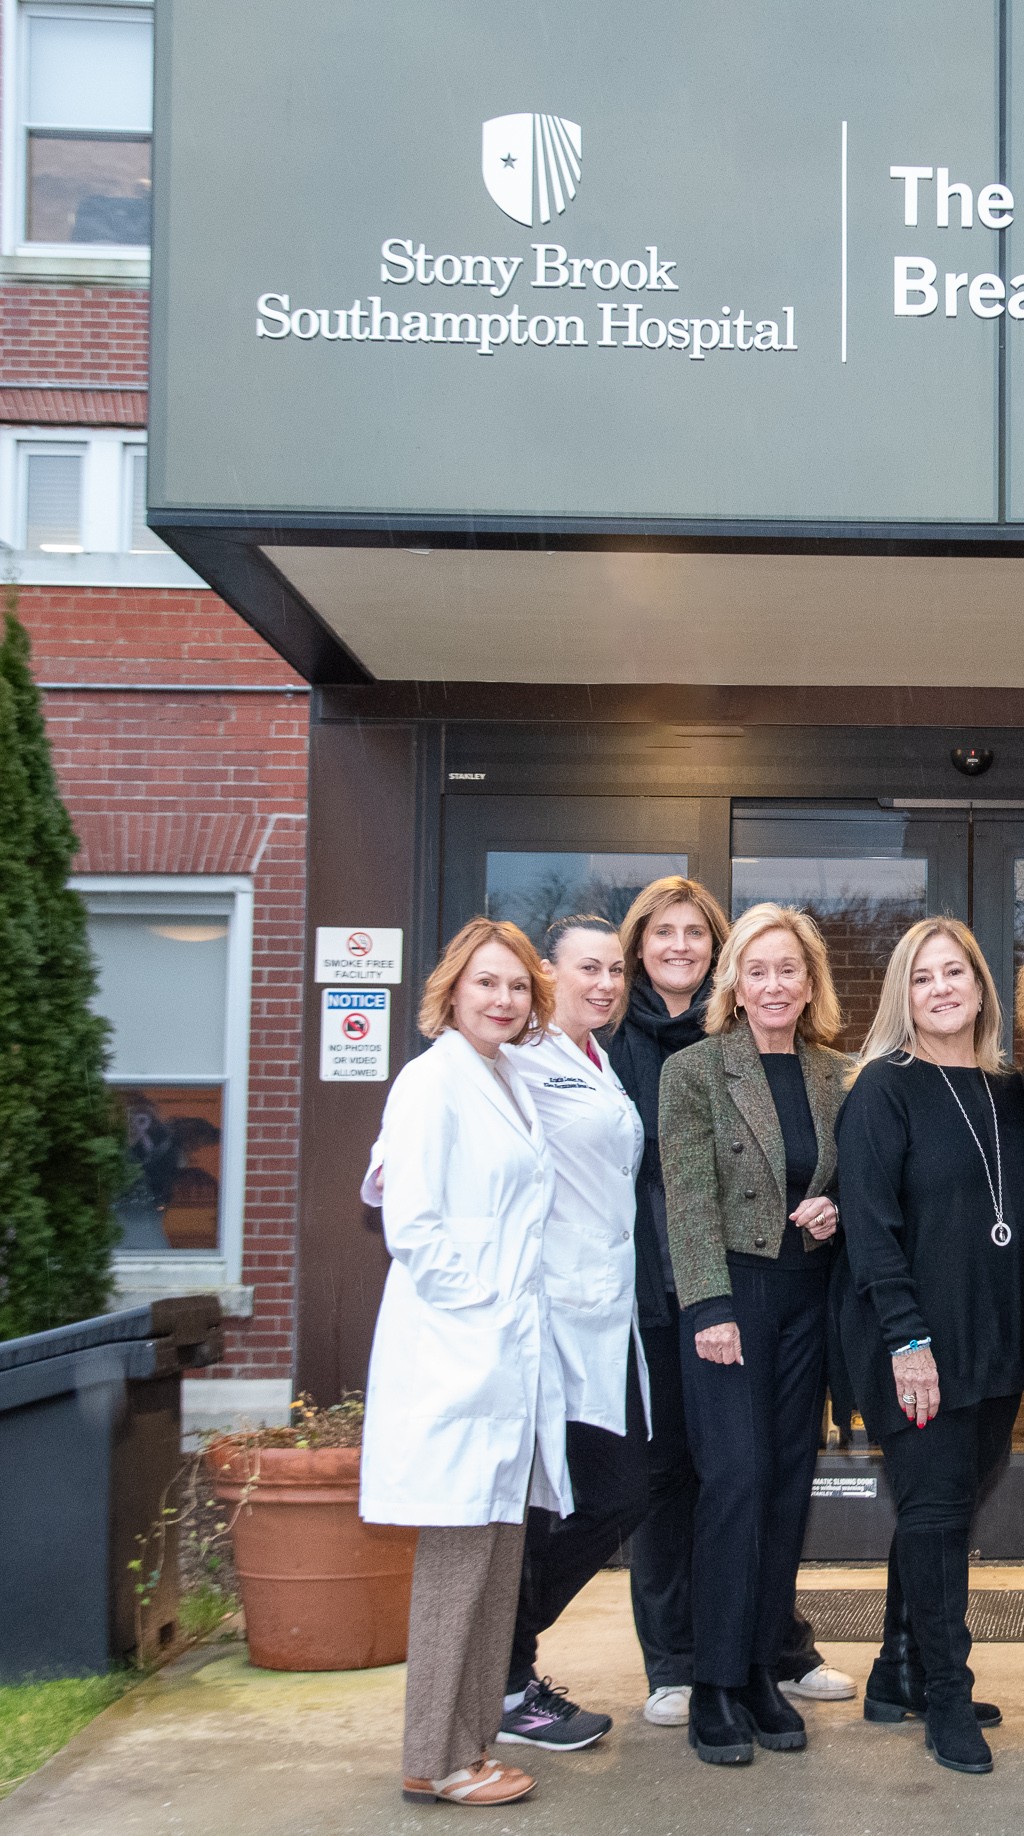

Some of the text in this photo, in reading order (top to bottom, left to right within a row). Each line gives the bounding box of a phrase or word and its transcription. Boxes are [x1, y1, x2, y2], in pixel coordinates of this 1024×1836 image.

[889, 164, 1015, 229] The
[380, 237, 679, 297] Stony Brook
[256, 291, 799, 360] Southampton Hospital
[448, 772, 487, 780] STANLEY
[323, 959, 394, 968] SMOKE FREE
[334, 970, 383, 979] FACILITY
[328, 994, 385, 1007] NOTICE
[329, 1044, 342, 1052] NO
[833, 1478, 856, 1486] SLIDING
[857, 1478, 873, 1486] DOOR
